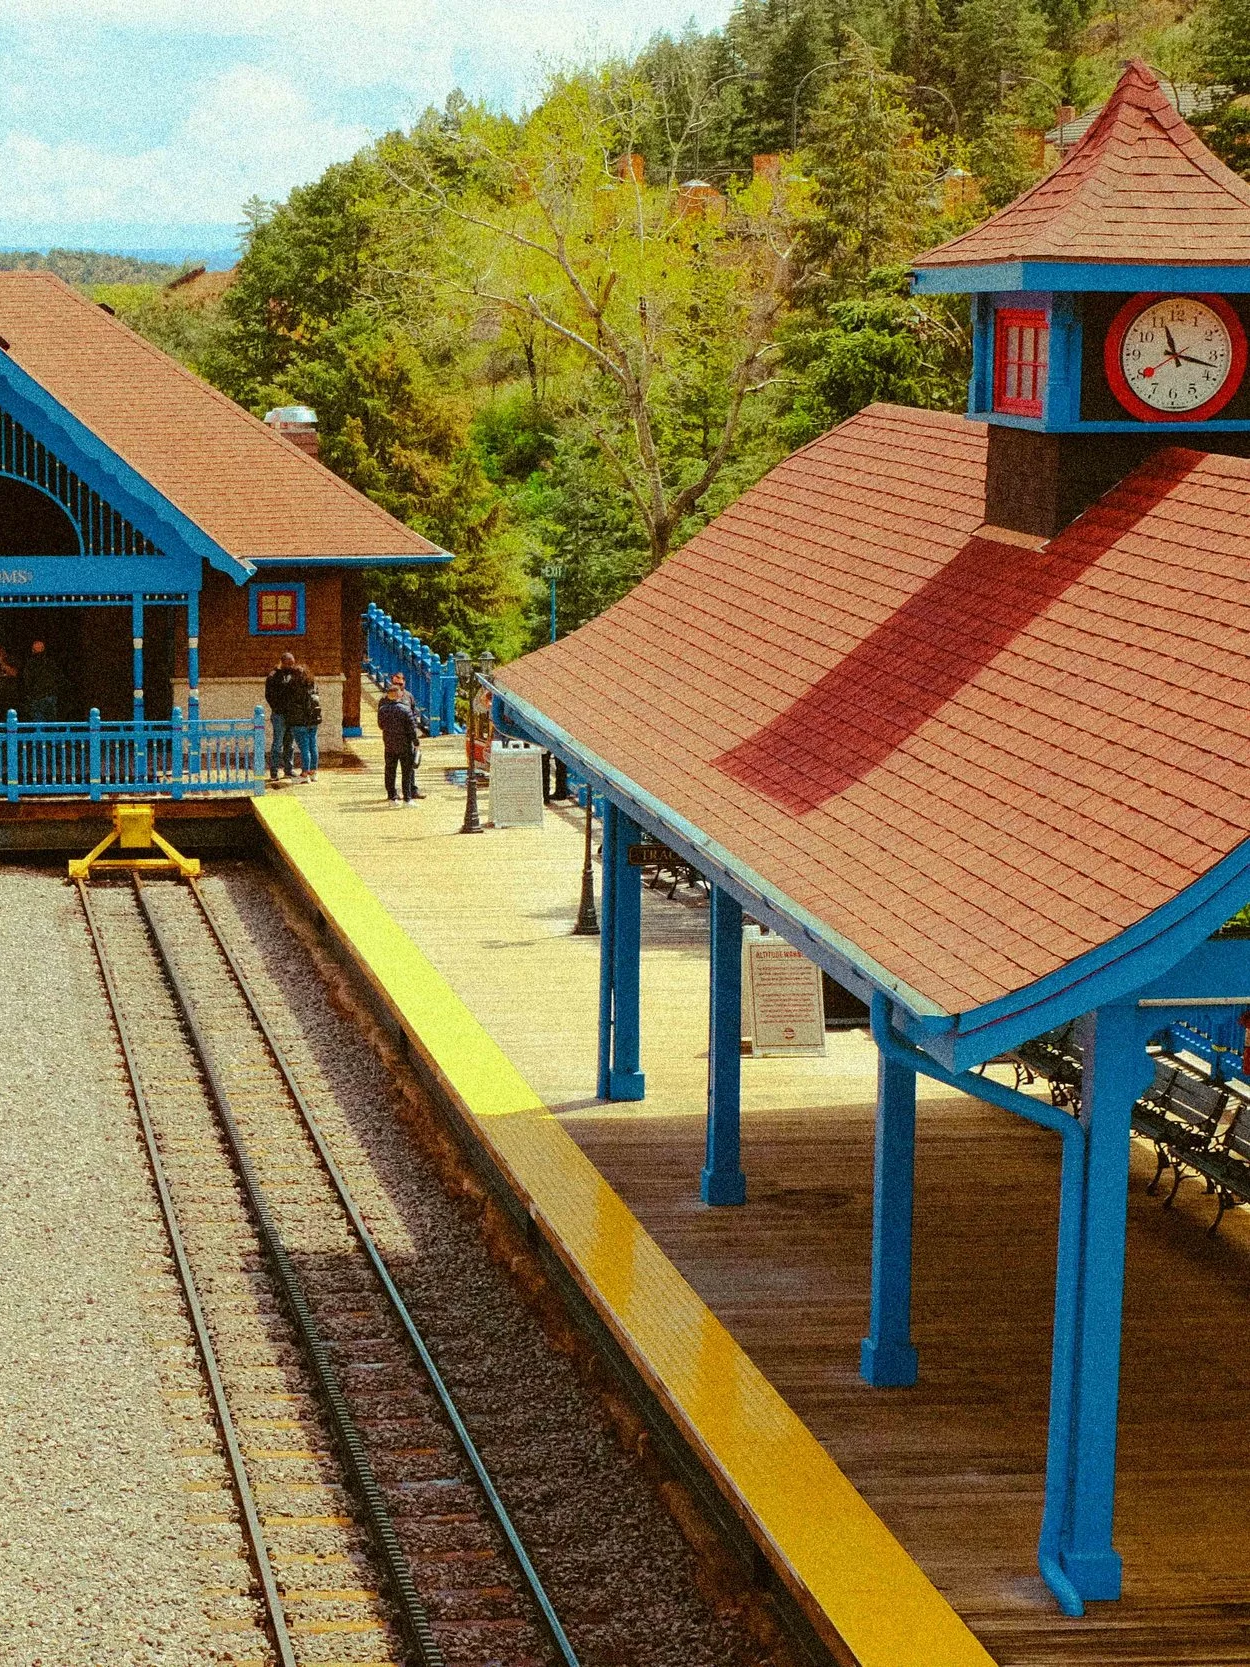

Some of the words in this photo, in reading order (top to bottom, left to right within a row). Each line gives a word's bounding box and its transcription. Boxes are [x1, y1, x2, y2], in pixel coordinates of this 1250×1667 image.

[1170, 309, 1185, 322] 12
[1152, 316, 1164, 328] 11
[1193, 317, 1199, 327] 1
[1139, 331, 1154, 343] 10
[1204, 330, 1213, 342] 2
[1132, 349, 1141, 361] 9
[1209, 350, 1218, 362] 3
[1202, 369, 1210, 381] 4
[1151, 382, 1159, 395] 7
[1168, 388, 1178, 400] 6
[1188, 383, 1197, 395] 5
[545, 565, 562, 577] EXIT
[642, 849, 680, 861] TRAC
